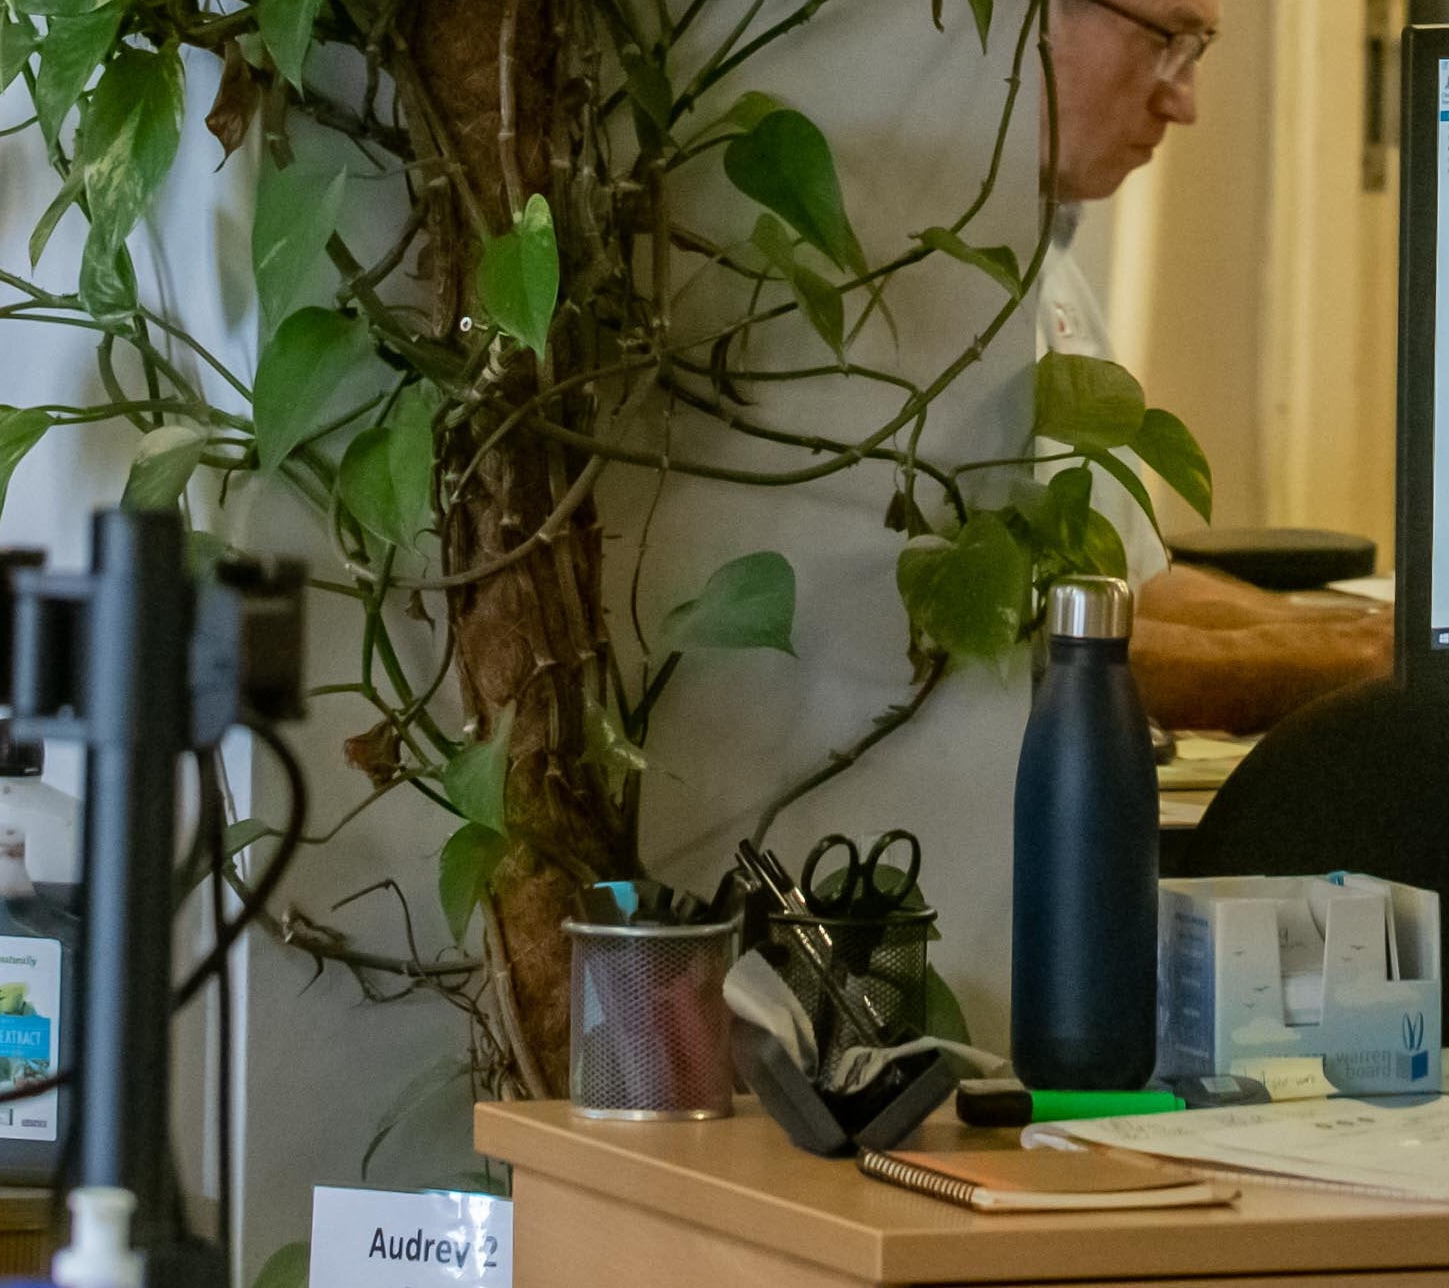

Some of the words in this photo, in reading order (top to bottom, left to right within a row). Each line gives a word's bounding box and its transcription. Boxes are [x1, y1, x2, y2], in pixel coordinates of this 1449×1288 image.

[0, 1029, 42, 1047] EXTRACT
[368, 1227, 471, 1269] Audrey
[482, 1236, 498, 1267] 2
